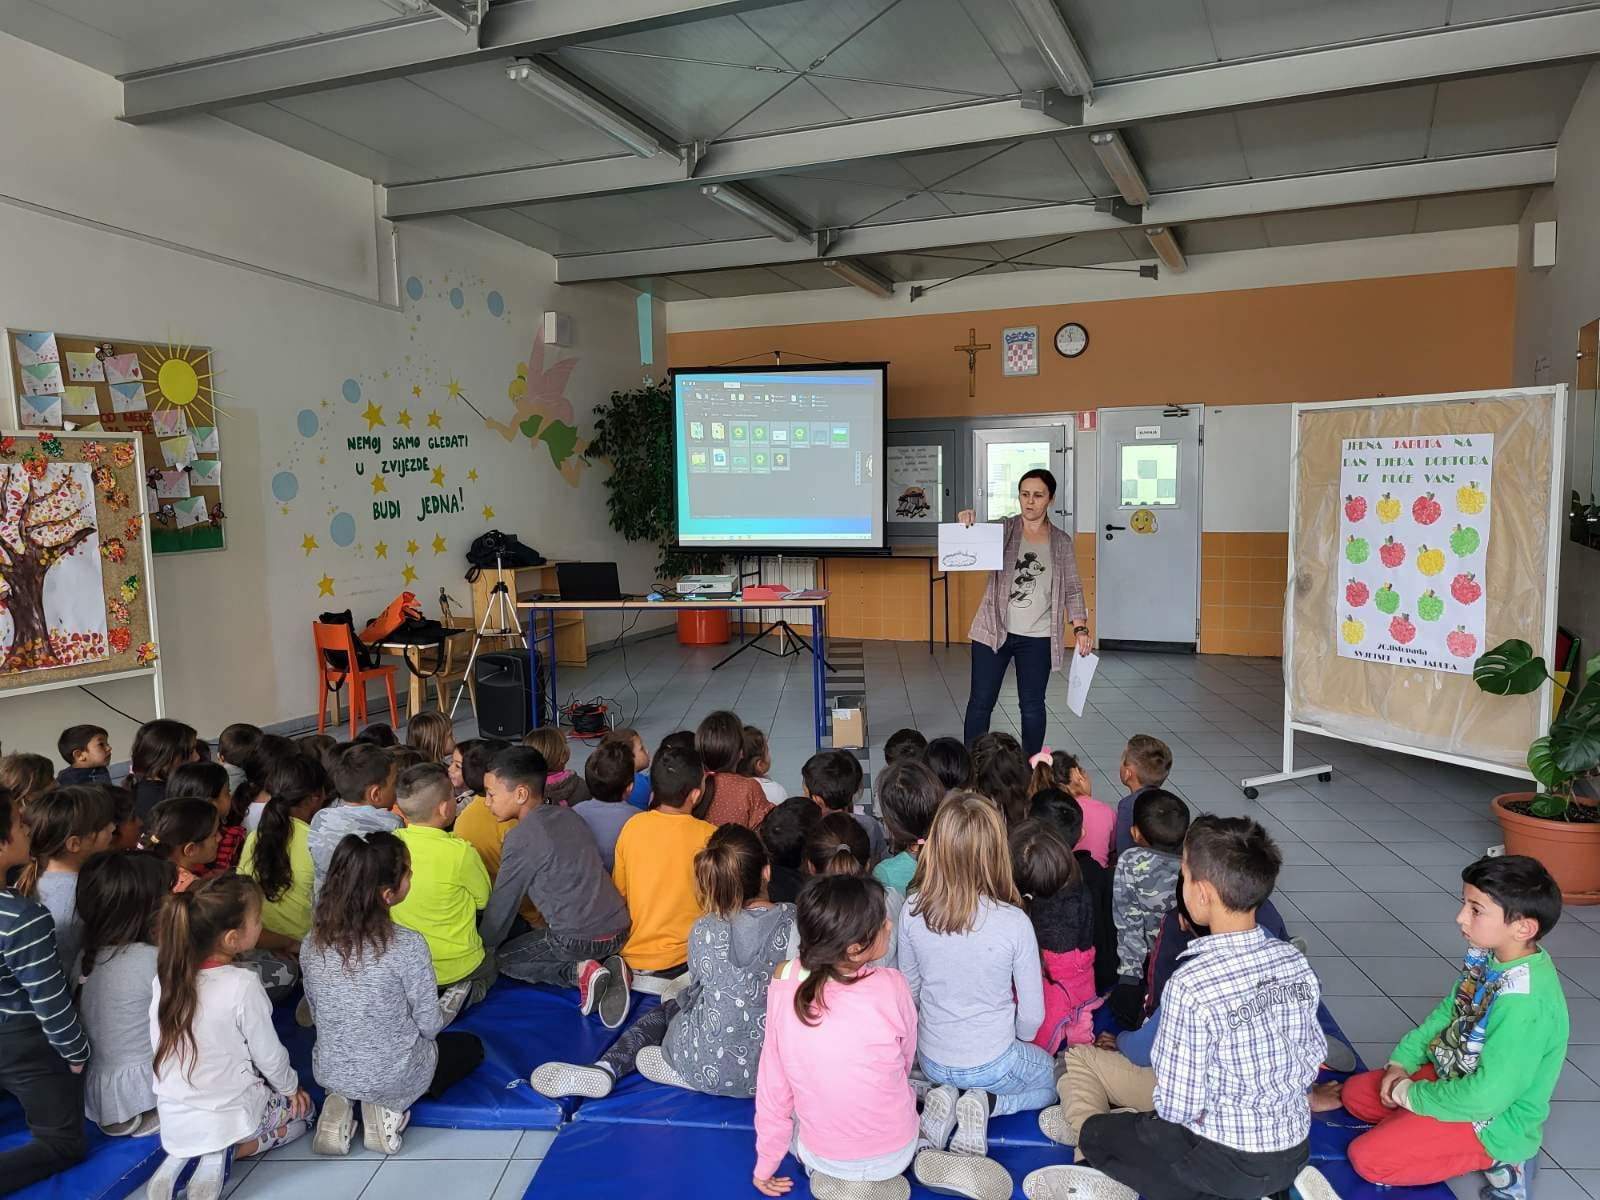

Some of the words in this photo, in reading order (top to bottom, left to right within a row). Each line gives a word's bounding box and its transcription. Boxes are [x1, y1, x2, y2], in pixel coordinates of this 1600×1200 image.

[347, 436, 382, 454] NEMOJ
[392, 436, 421, 450] SAMO
[427, 434, 469, 449] GLEDATI
[1453, 437, 1473, 447] NA
[355, 462, 365, 476] U
[381, 457, 430, 478] ZVIJEZDE
[1424, 455, 1489, 467] DOKTORA
[1357, 473, 1369, 483] IZ
[1424, 473, 1456, 483] VAN!
[372, 500, 401, 521] BUDI
[416, 486, 465, 522] JEDNA!
[1226, 991, 1269, 1031] COLD
[1268, 981, 1314, 1006] RIVER
